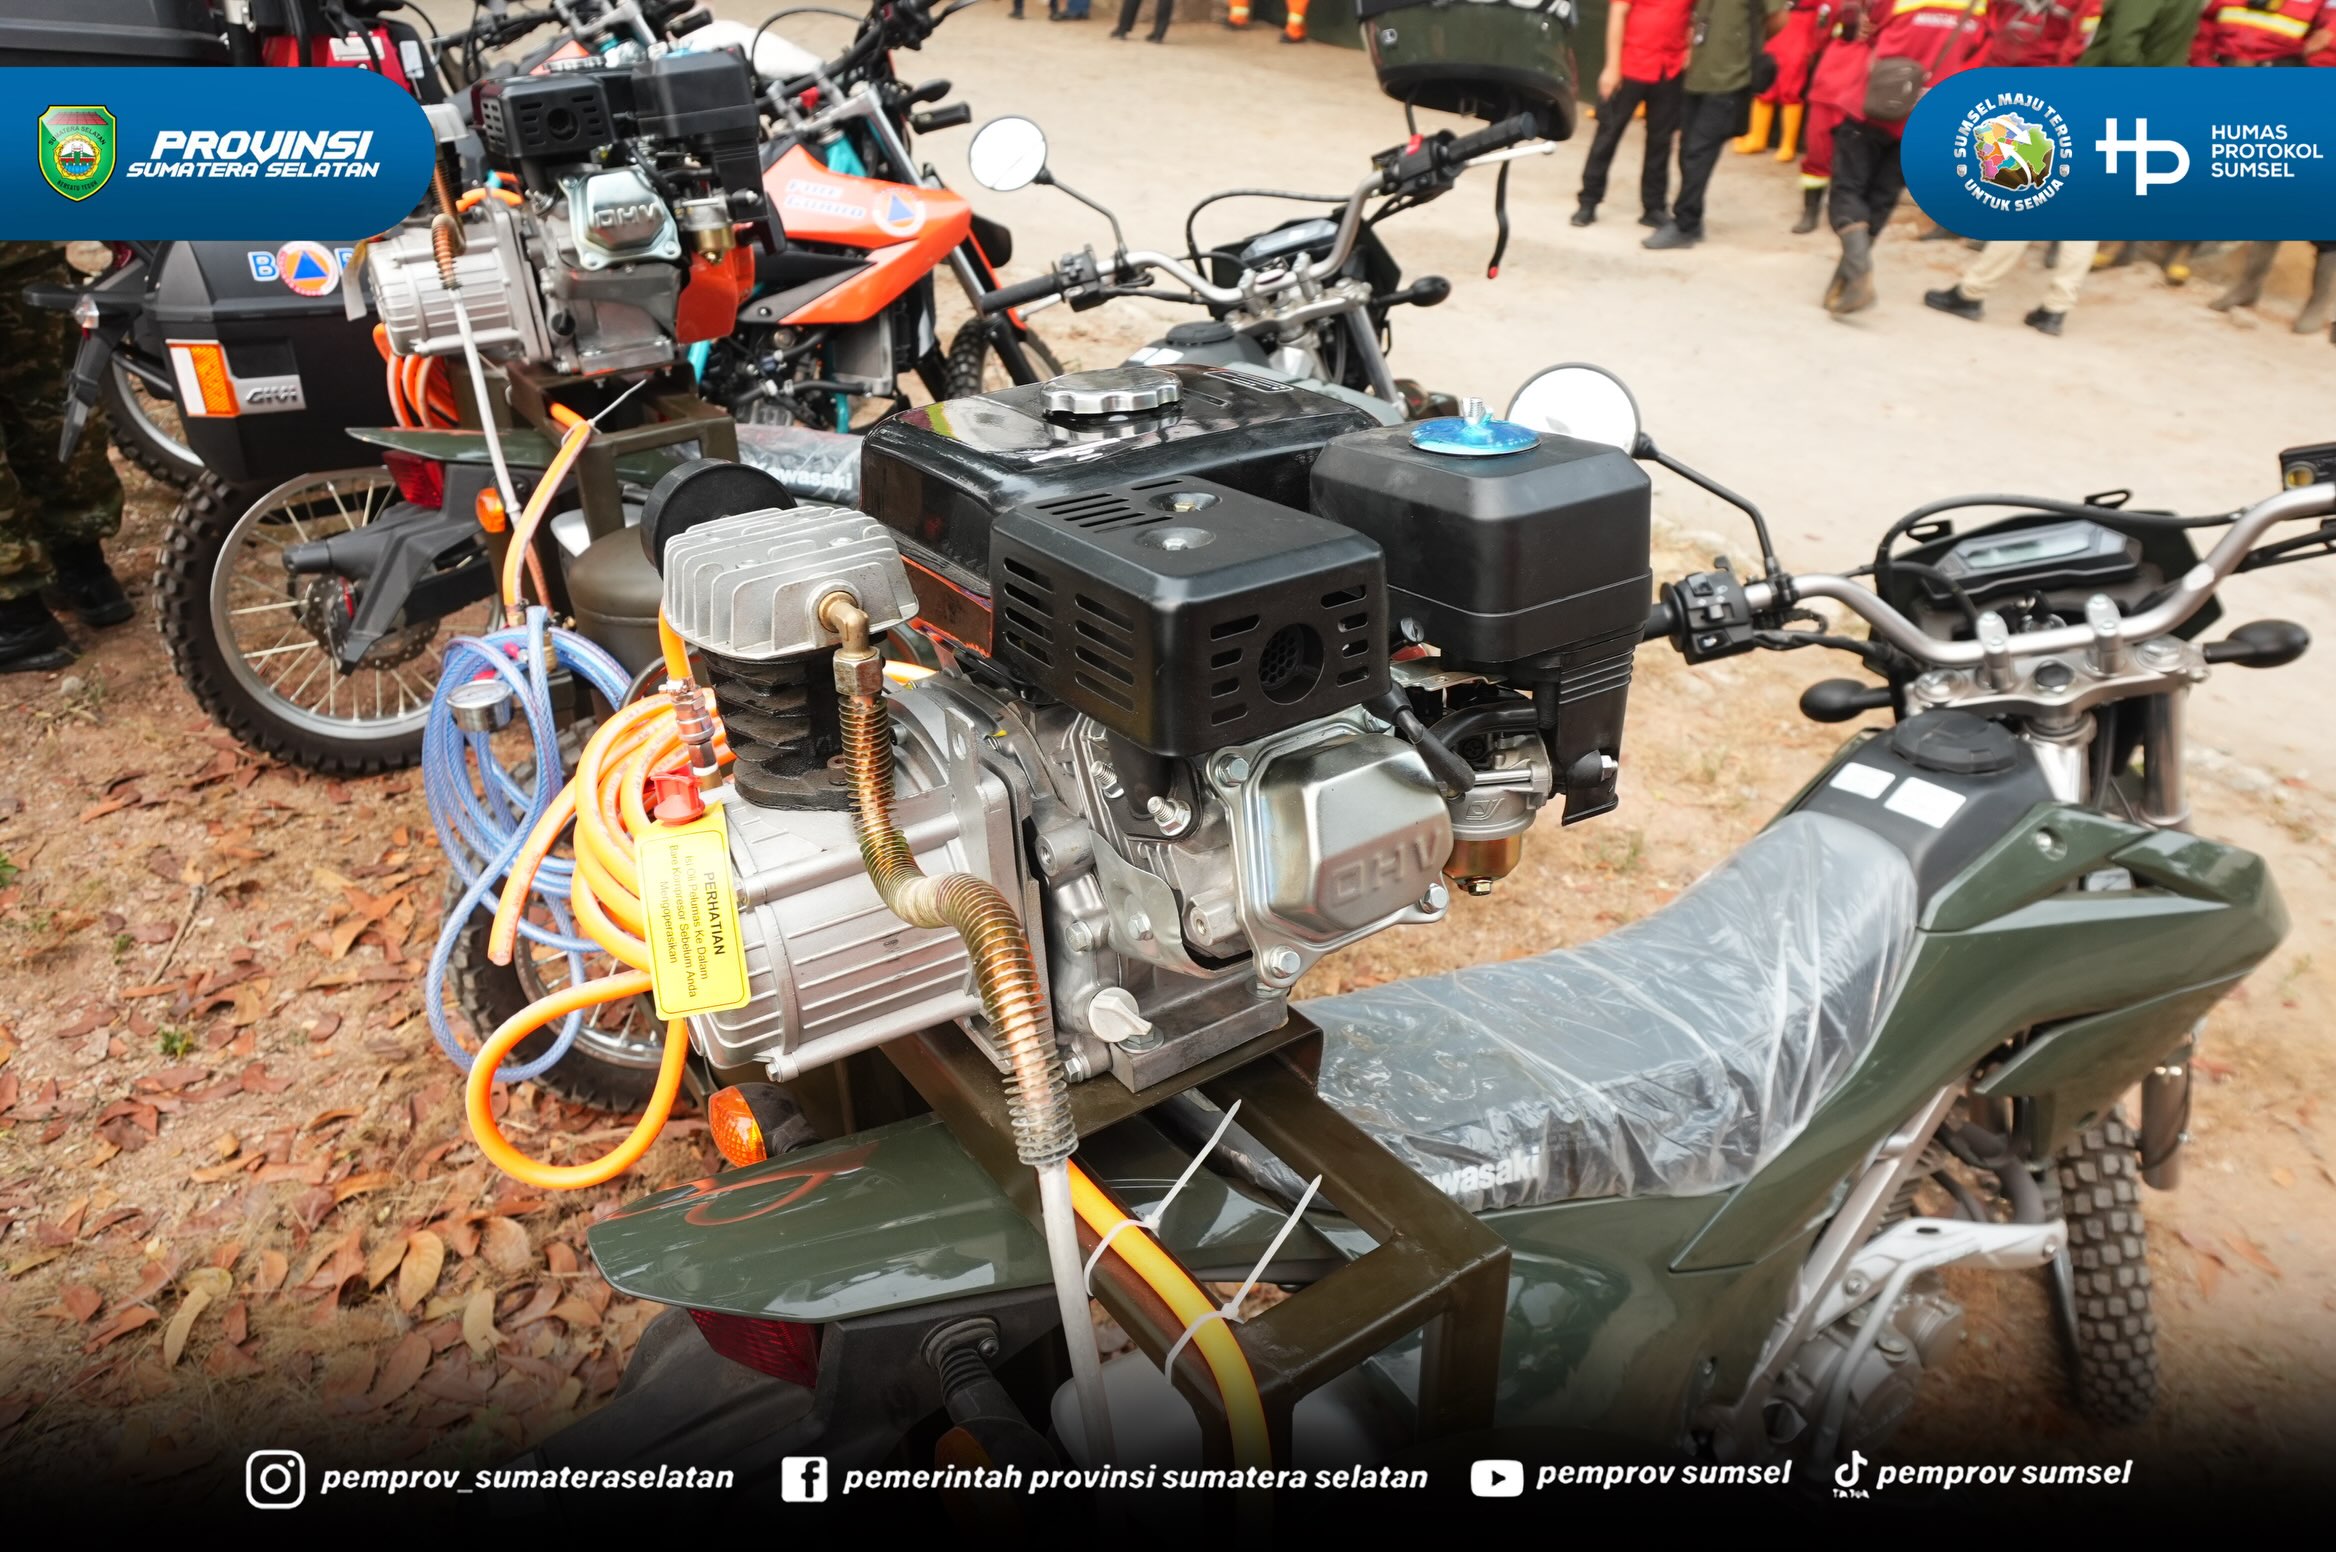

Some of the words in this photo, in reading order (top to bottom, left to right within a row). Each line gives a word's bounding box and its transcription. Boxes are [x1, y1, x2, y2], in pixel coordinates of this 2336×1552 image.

[594, 203, 657, 228] OHV
[1331, 828, 1444, 906] OHV
[688, 883, 701, 928] Pelumas
[703, 872, 726, 956] PERHATIAN
[680, 923, 692, 968] Sebelum
[686, 971, 698, 997] Anda
[695, 930, 705, 944] Ke
[697, 946, 709, 980] Dalam
[1424, 1146, 1541, 1196] wasaki
